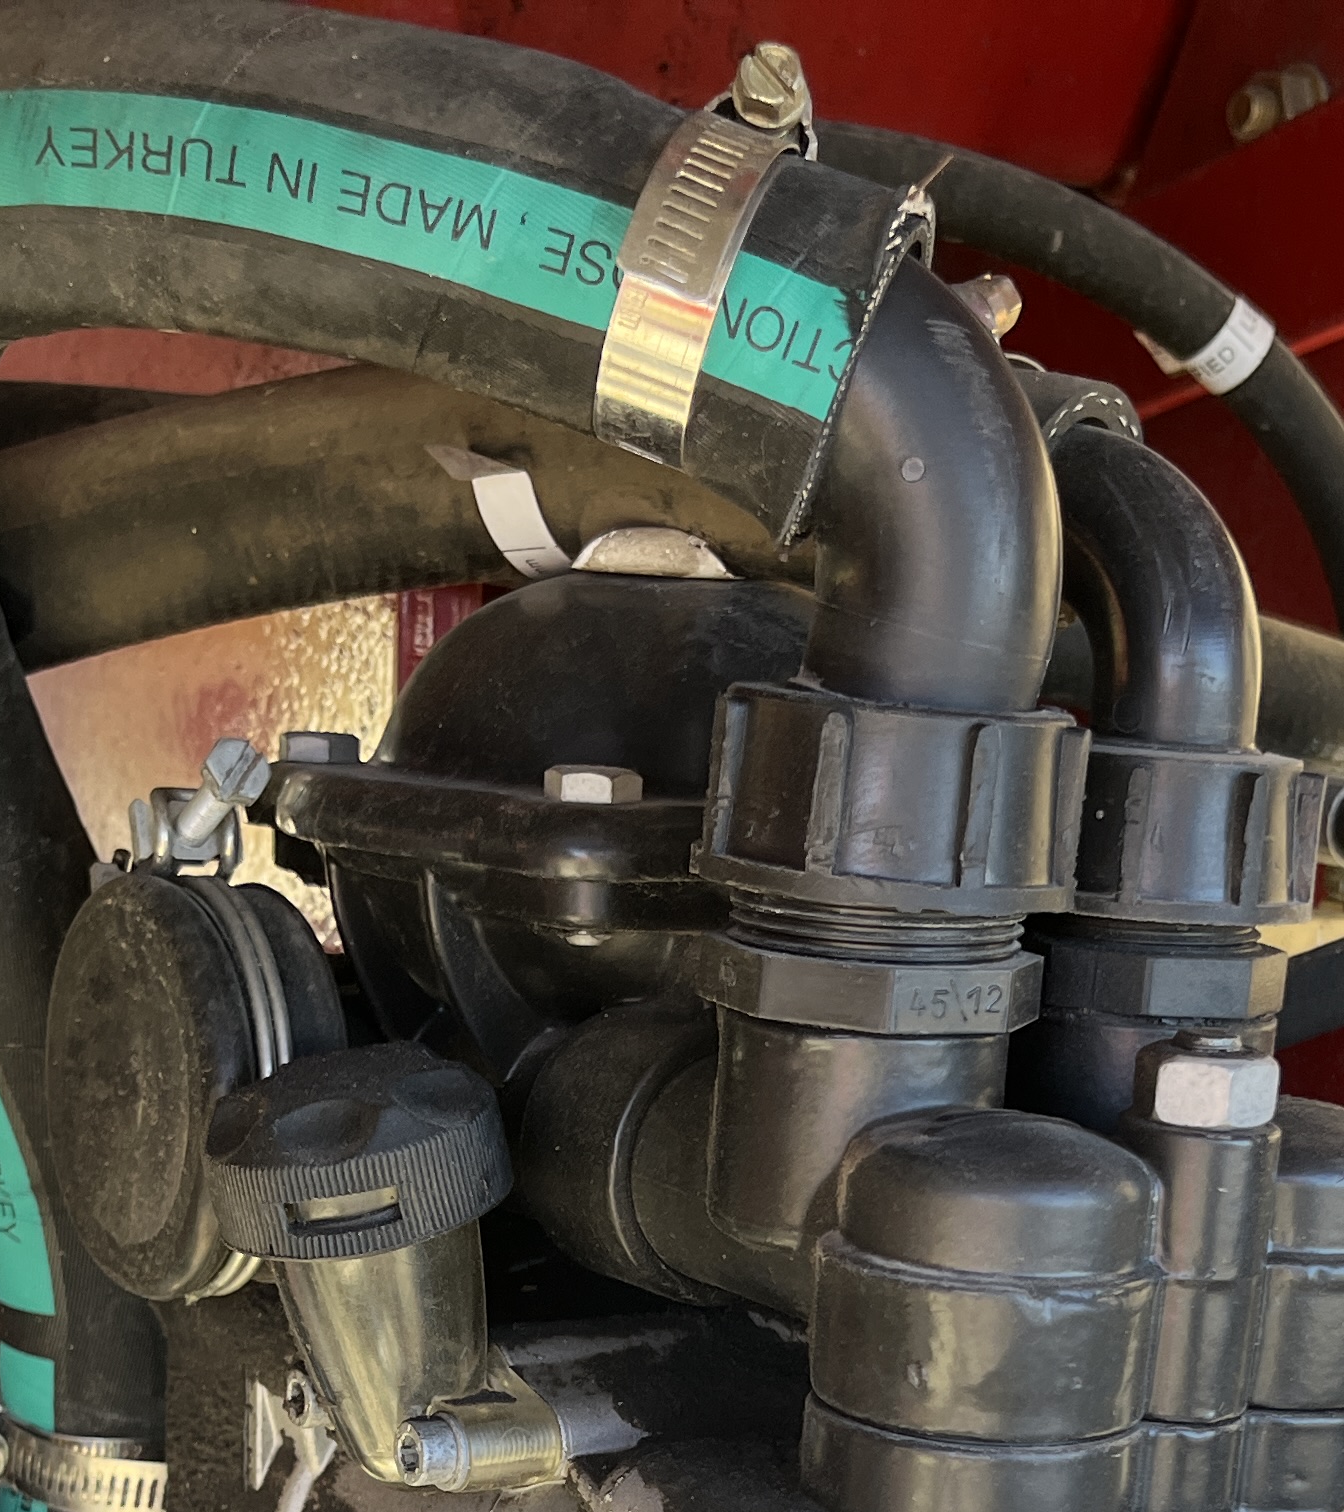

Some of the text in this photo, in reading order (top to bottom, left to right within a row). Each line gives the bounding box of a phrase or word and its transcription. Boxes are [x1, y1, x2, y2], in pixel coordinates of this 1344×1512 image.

[34, 125, 247, 188] TURKEY
[266, 152, 319, 204] IN
[336, 168, 498, 252] MADE
